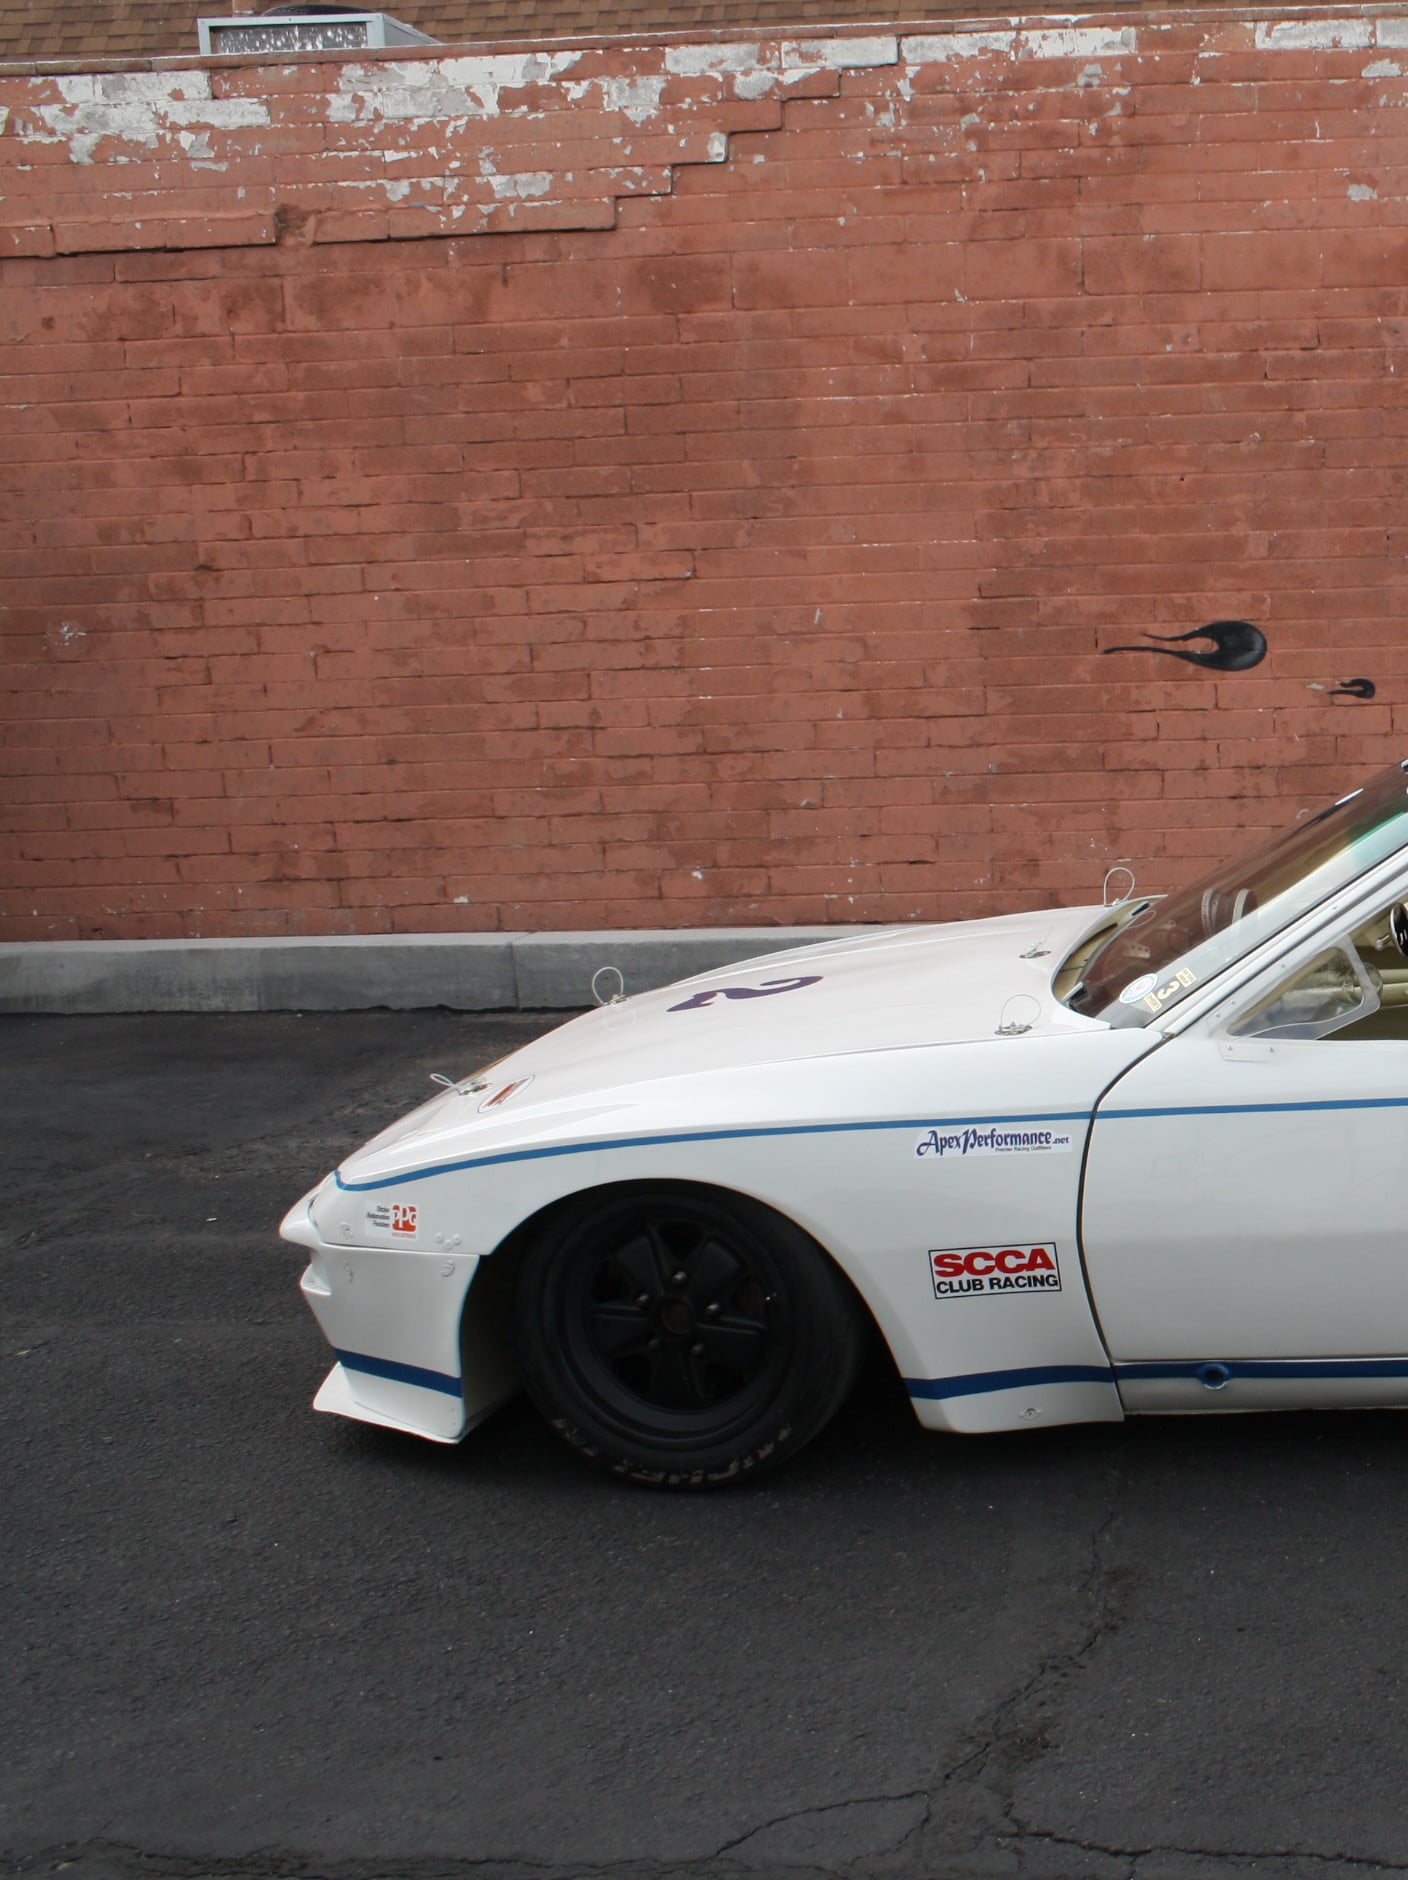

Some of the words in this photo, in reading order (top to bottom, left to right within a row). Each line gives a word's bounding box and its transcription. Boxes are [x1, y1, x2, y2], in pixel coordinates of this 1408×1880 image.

[391, 1208, 417, 1229] PPG
[933, 1248, 1055, 1277] SCCA
[936, 1278, 985, 1294] CLUB
[988, 1274, 1058, 1290] RACING
